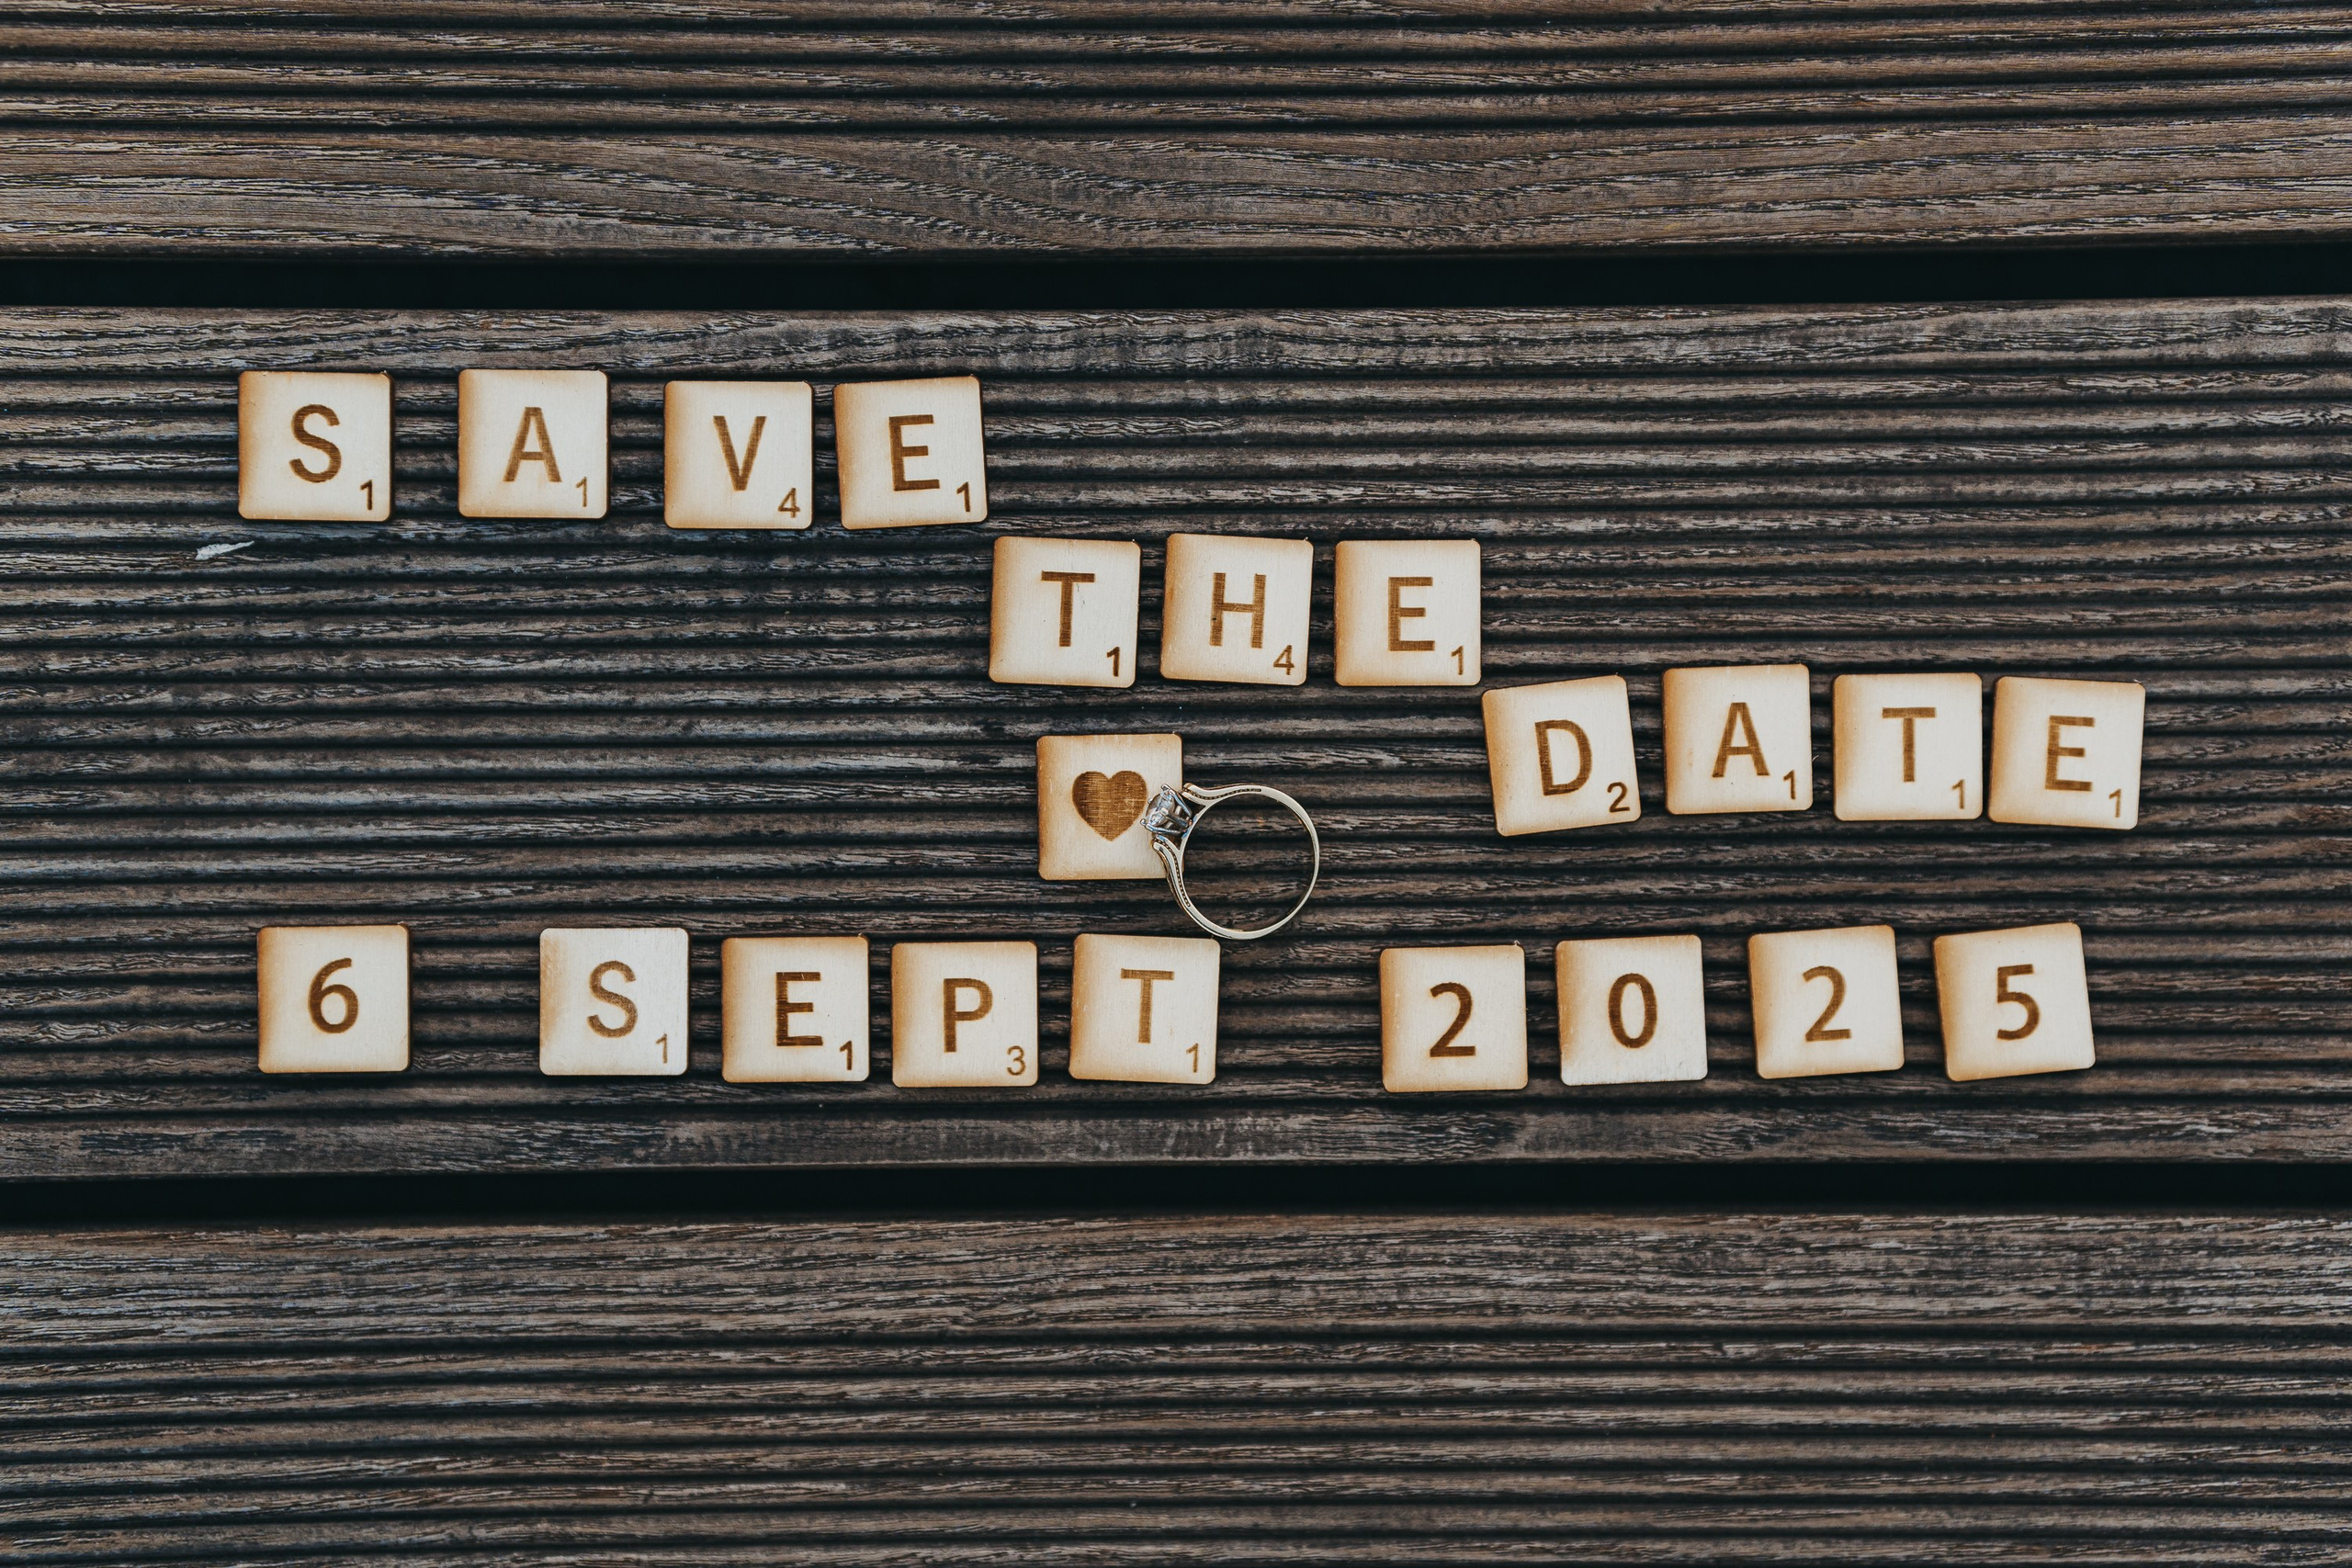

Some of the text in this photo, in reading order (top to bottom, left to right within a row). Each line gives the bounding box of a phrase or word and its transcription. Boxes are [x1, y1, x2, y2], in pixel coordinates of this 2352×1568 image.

[288, 403, 941, 492] SAVE
[359, 476, 972, 519] 1 1 4 1
[1040, 570, 1436, 652] THE
[1106, 644, 1464, 678] 1 4 1
[1533, 701, 2096, 797] DATE
[1606, 769, 2121, 818] 2 1 1 1
[307, 957, 2041, 1058] 6 SEPT 2025
[655, 1032, 1199, 1077] 1 1 3 1
